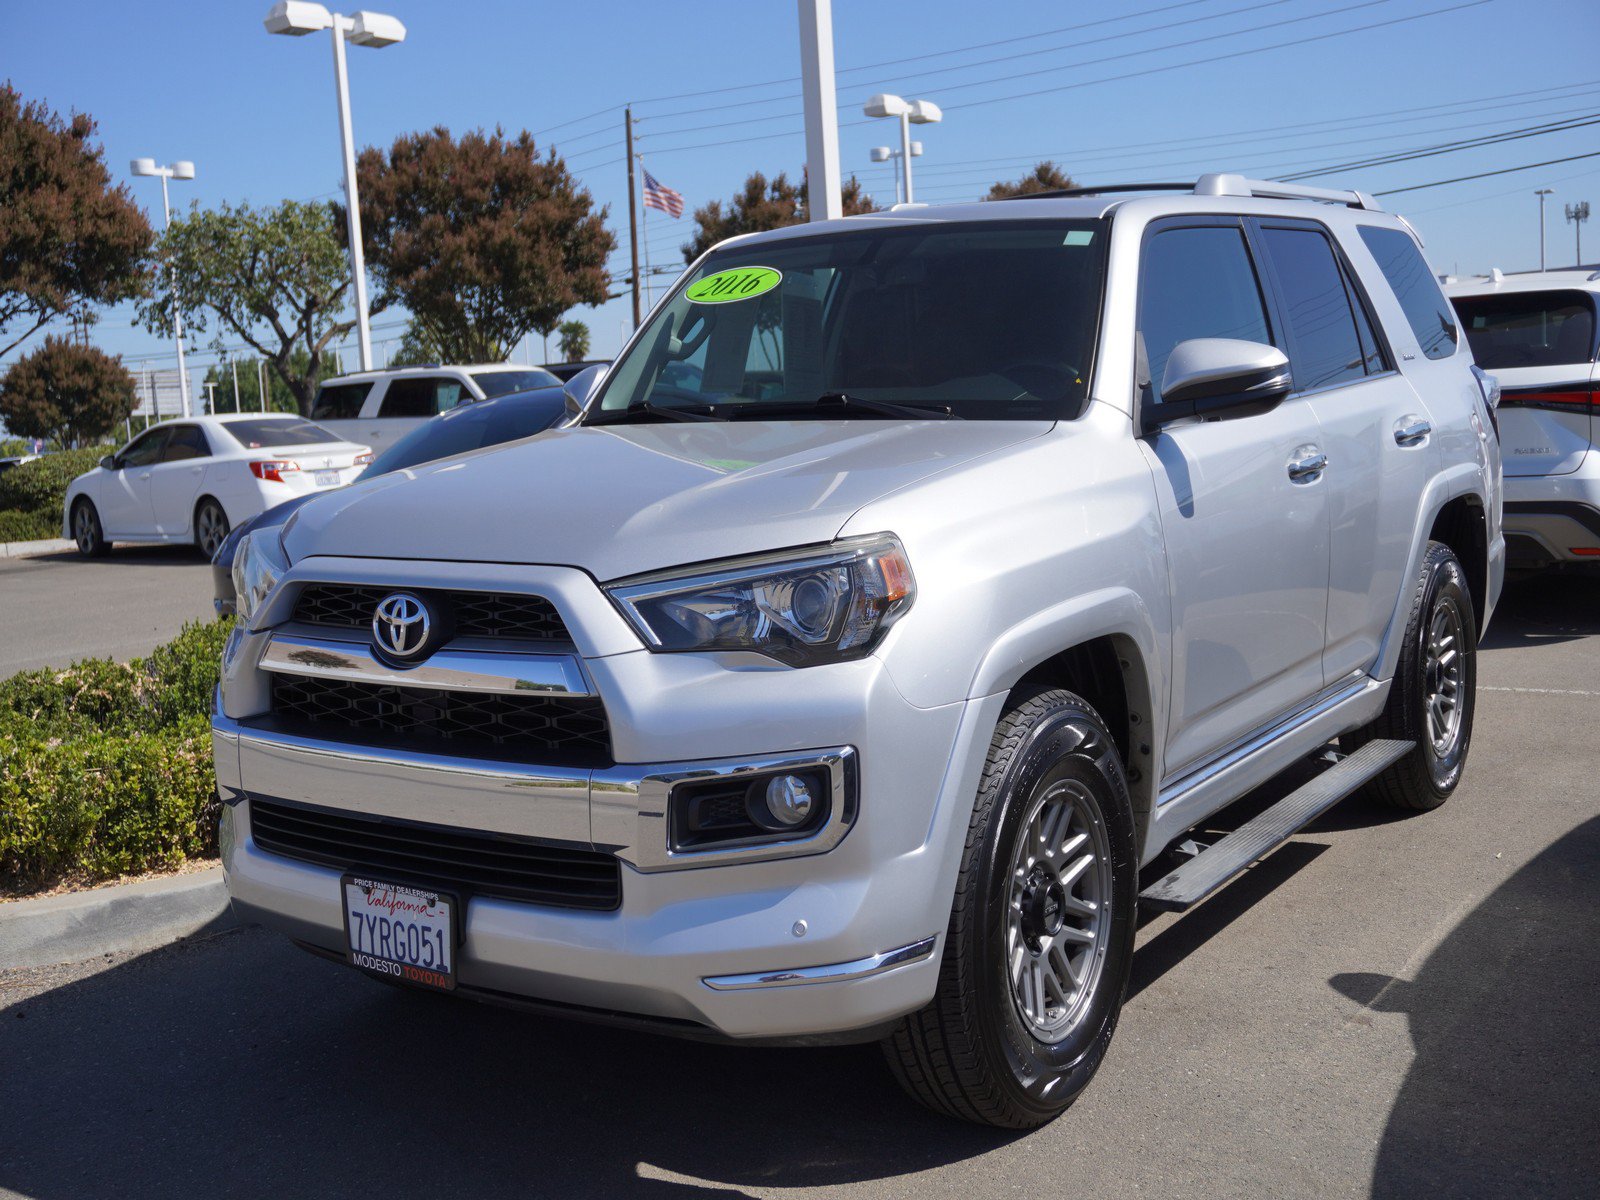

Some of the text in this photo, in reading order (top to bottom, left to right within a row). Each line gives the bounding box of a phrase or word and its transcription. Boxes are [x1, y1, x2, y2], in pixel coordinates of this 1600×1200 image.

[694, 272, 771, 297] 2016
[354, 878, 439, 901] PRICE FAMILY DEALERSHIPS
[367, 887, 434, 917] California
[352, 911, 448, 973] 7YRG051
[353, 953, 445, 988] MODESTO TOYOTA
